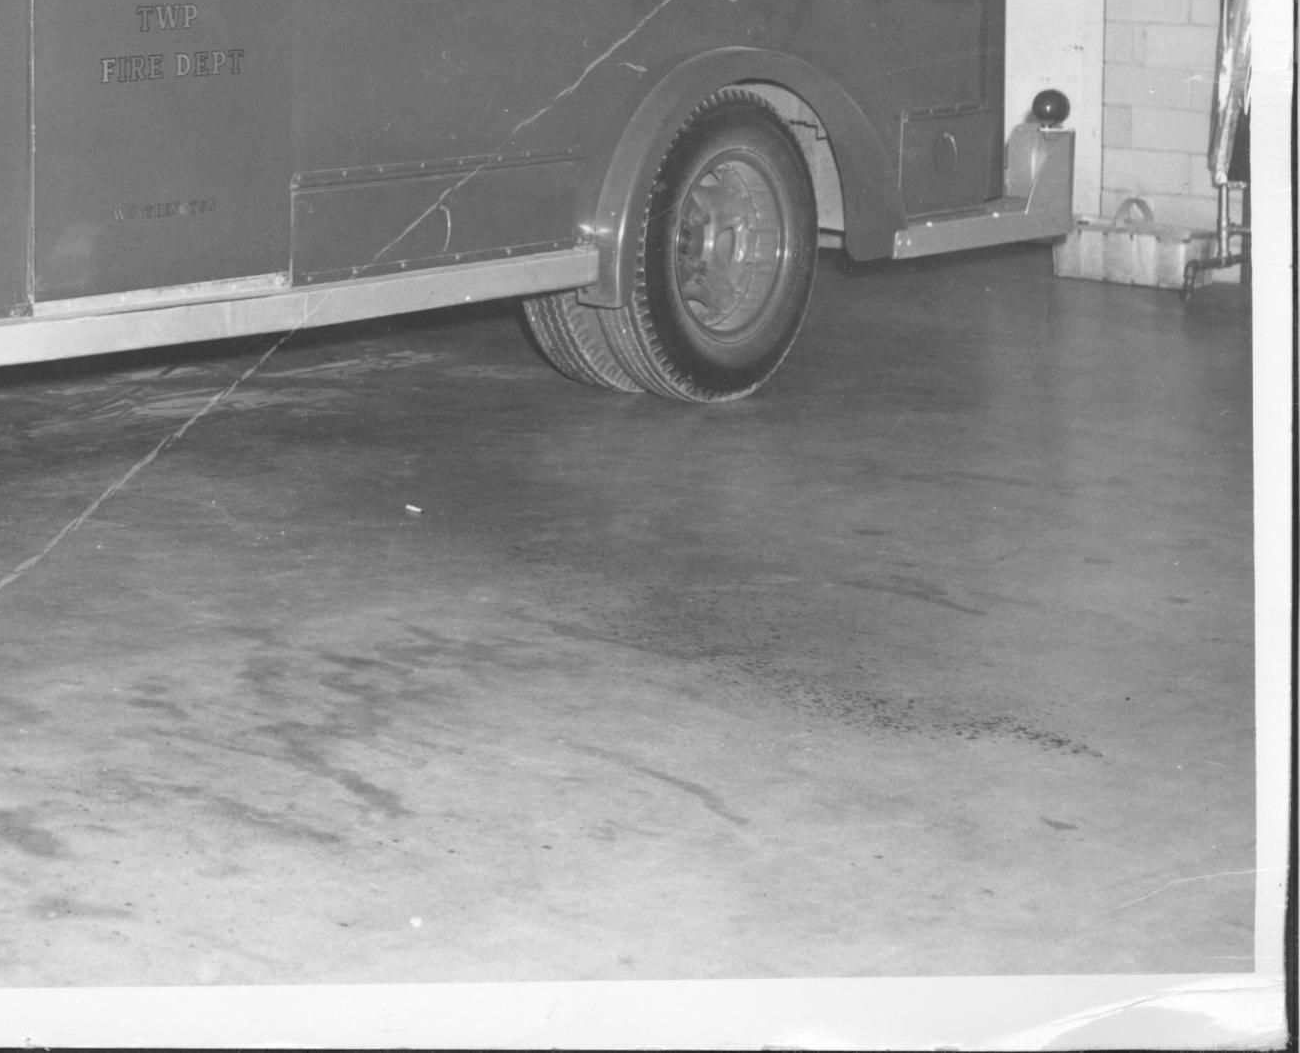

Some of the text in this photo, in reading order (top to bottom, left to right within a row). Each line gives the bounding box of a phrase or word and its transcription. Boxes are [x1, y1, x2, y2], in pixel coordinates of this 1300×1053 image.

[136, 3, 198, 32] TWP
[100, 49, 245, 84] FIRE DEPT
